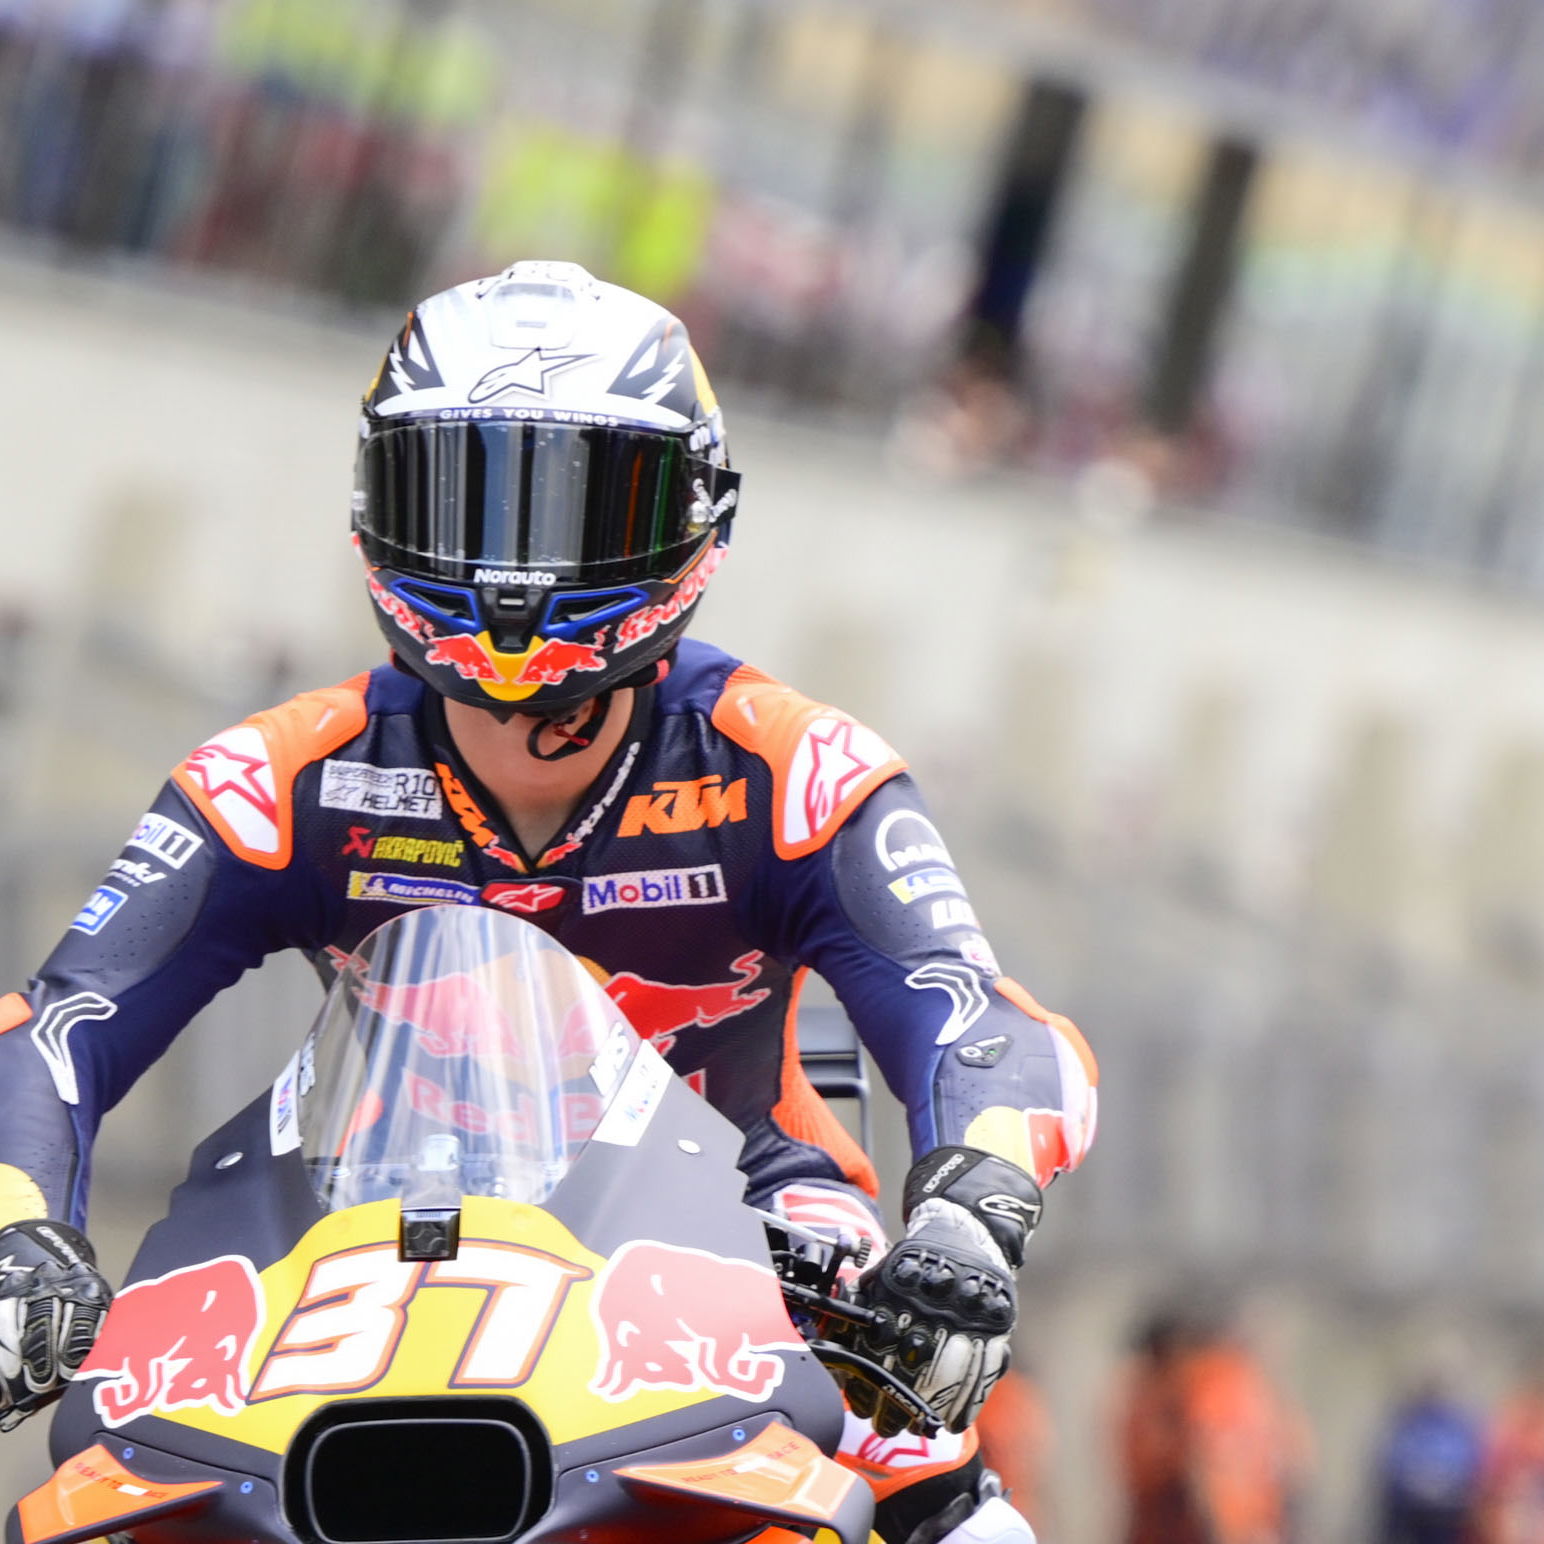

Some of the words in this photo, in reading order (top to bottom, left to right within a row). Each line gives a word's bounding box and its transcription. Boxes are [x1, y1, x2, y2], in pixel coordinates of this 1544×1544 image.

[439, 408, 493, 420] GIVES
[502, 408, 545, 421] YOU
[552, 410, 619, 428] WINGS
[472, 567, 557, 586] Norauto
[394, 772, 438, 797] R10
[360, 792, 437, 815] HELMET
[616, 774, 748, 838] KTM
[387, 882, 475, 904] MICHELIN
[588, 873, 682, 909] Mobil
[247, 1238, 595, 1406] 37
